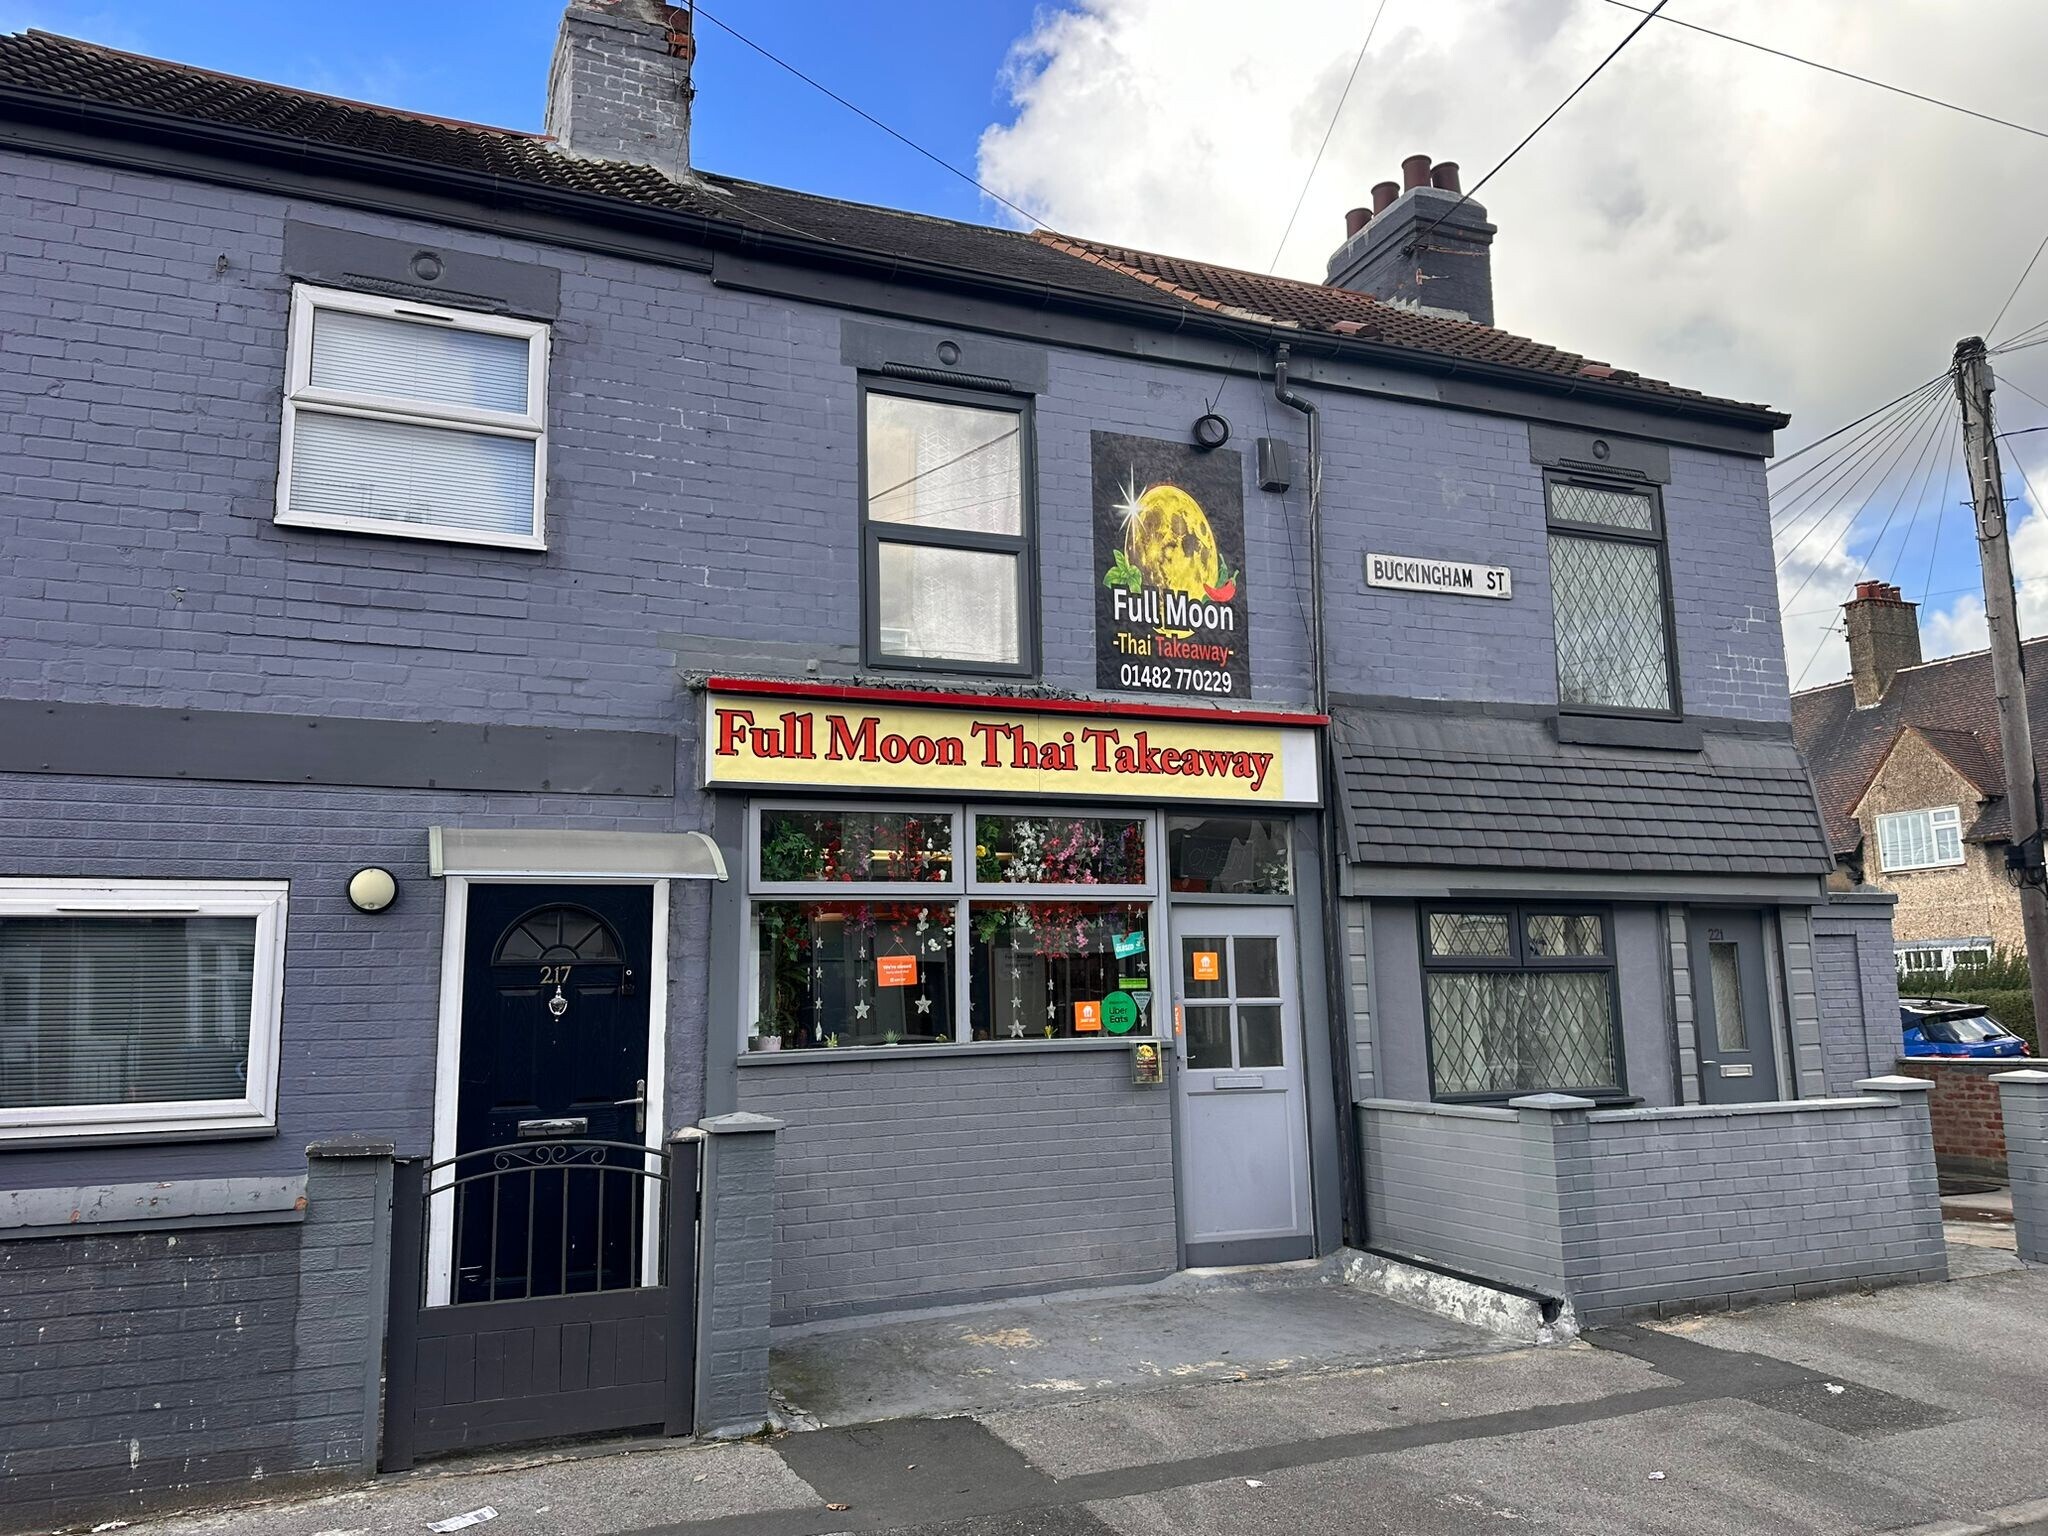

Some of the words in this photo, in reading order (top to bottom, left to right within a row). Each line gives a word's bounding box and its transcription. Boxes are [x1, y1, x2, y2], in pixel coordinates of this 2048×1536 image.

[1374, 560, 1473, 588] BUCKINGHAM
[1487, 571, 1505, 591] ST
[1113, 588, 1159, 624] Full
[1166, 594, 1234, 631] Moon
[1120, 664, 1172, 689] 01482
[1175, 668, 1232, 693] 770229
[715, 708, 815, 760] Full
[825, 715, 966, 766] Moon
[971, 721, 1079, 771] Thai
[1081, 726, 1273, 791] Takeaway
[1707, 928, 1724, 941] 221
[540, 965, 572, 985] 217
[1109, 1007, 1128, 1015] Uber
[1109, 1015, 1128, 1023] Eats
